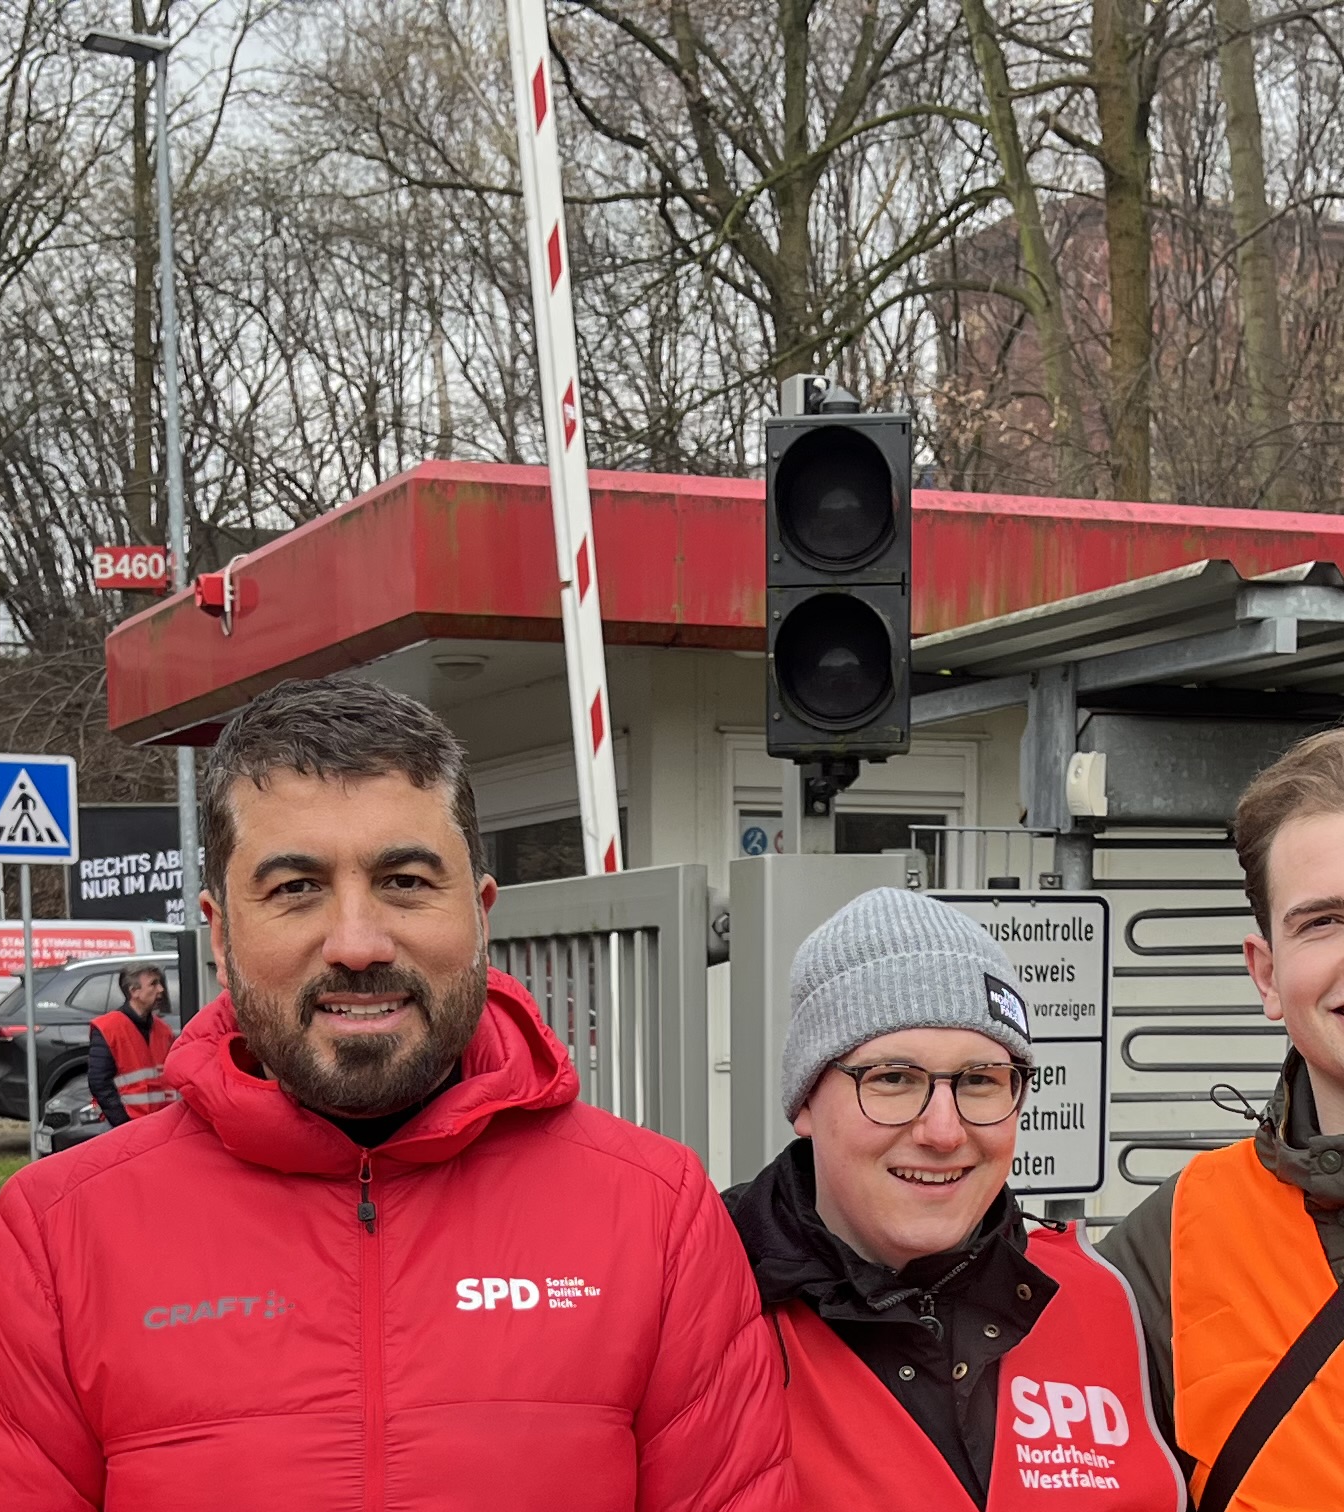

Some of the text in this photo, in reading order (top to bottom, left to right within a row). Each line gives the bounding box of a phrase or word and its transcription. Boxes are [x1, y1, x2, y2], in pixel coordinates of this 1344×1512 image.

[94, 552, 165, 579] B460
[80, 853, 151, 879] RECHTS
[81, 871, 184, 900] NUR IM AUT
[981, 916, 1094, 942] uskontrolle
[1033, 999, 1096, 1021] vorzeigen
[1030, 1065, 1066, 1093] gen
[1019, 1102, 1085, 1131] atmüll
[1012, 1151, 1055, 1176] oten
[456, 1277, 585, 1311] SPD Soziale
[548, 1286, 601, 1298] Politik für
[549, 1299, 577, 1309] Dich.
[143, 1296, 260, 1329] CRAFT
[1010, 1375, 1130, 1447] SPD
[1016, 1443, 1115, 1469] Nordrhein-
[1019, 1468, 1120, 1489] Westfalen
